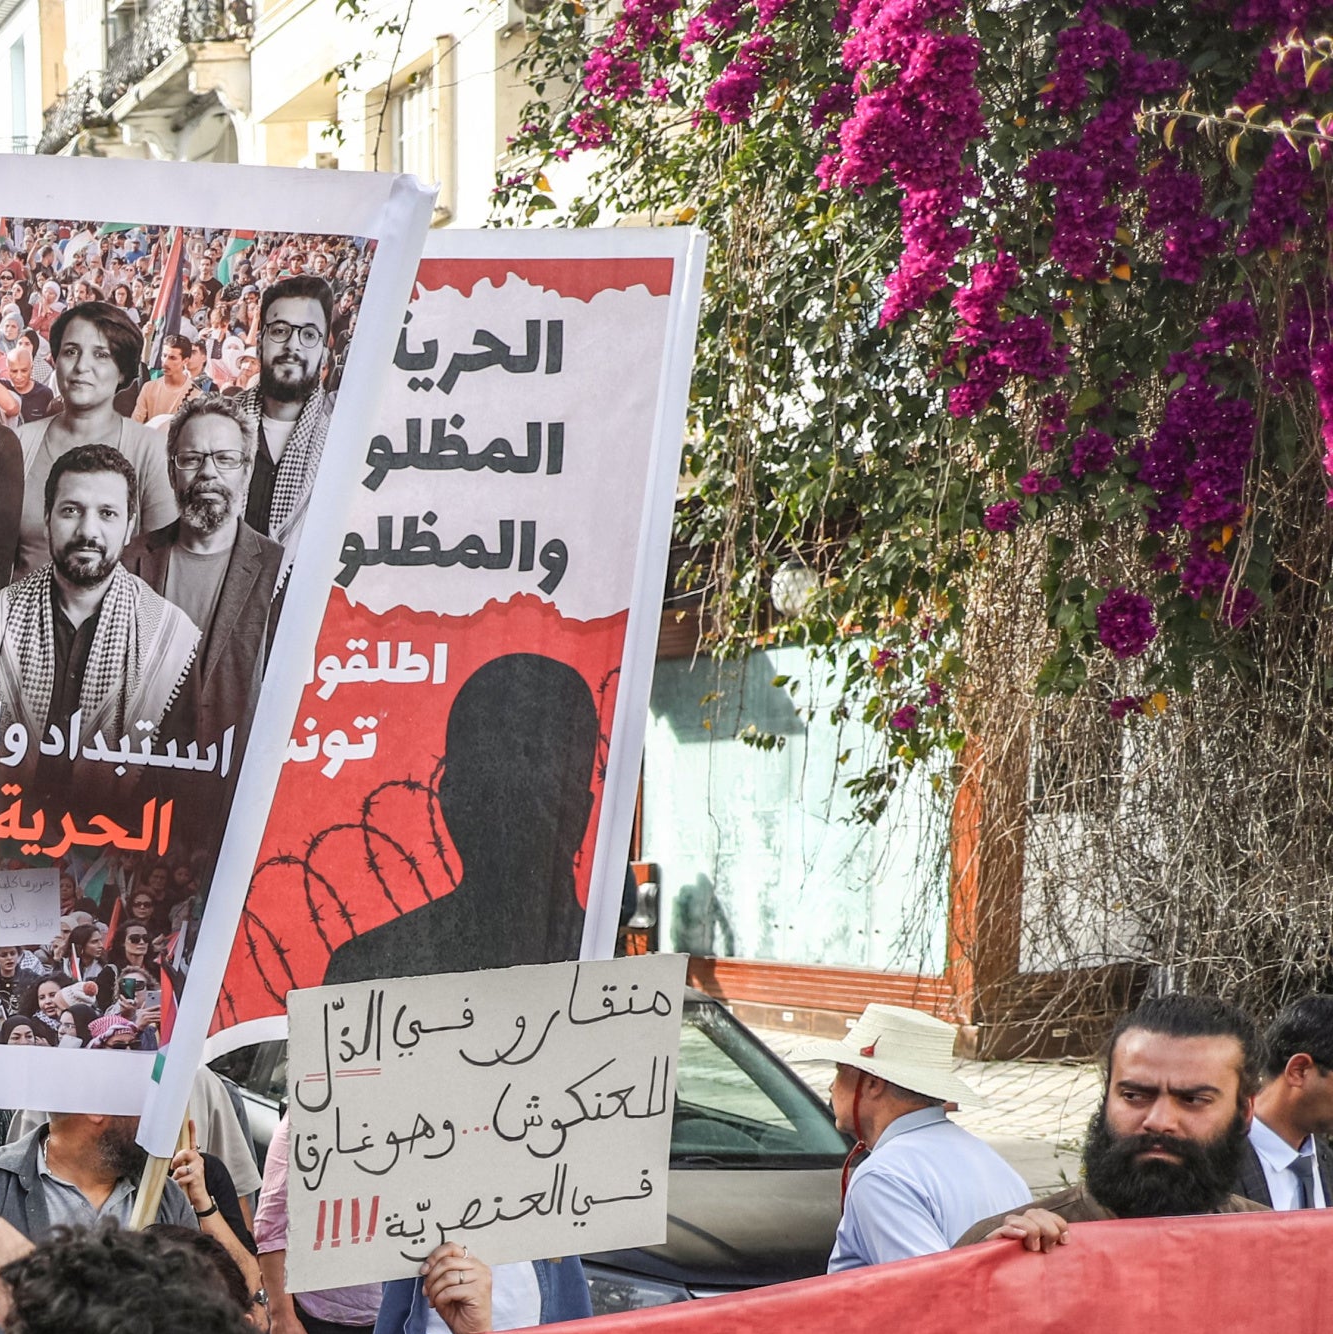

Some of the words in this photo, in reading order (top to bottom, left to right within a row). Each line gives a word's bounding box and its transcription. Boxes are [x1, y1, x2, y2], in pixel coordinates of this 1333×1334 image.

[361, 413, 565, 492] المظلو
[334, 510, 568, 596] والمظلو
[301, 637, 448, 701] اطلقو
[39, 709, 236, 777] استبداد
[392, 997, 475, 1059] في
[293, 1107, 374, 1191] غارق
[353, 1113, 456, 1175] وهو
[571, 1169, 653, 1227] في
